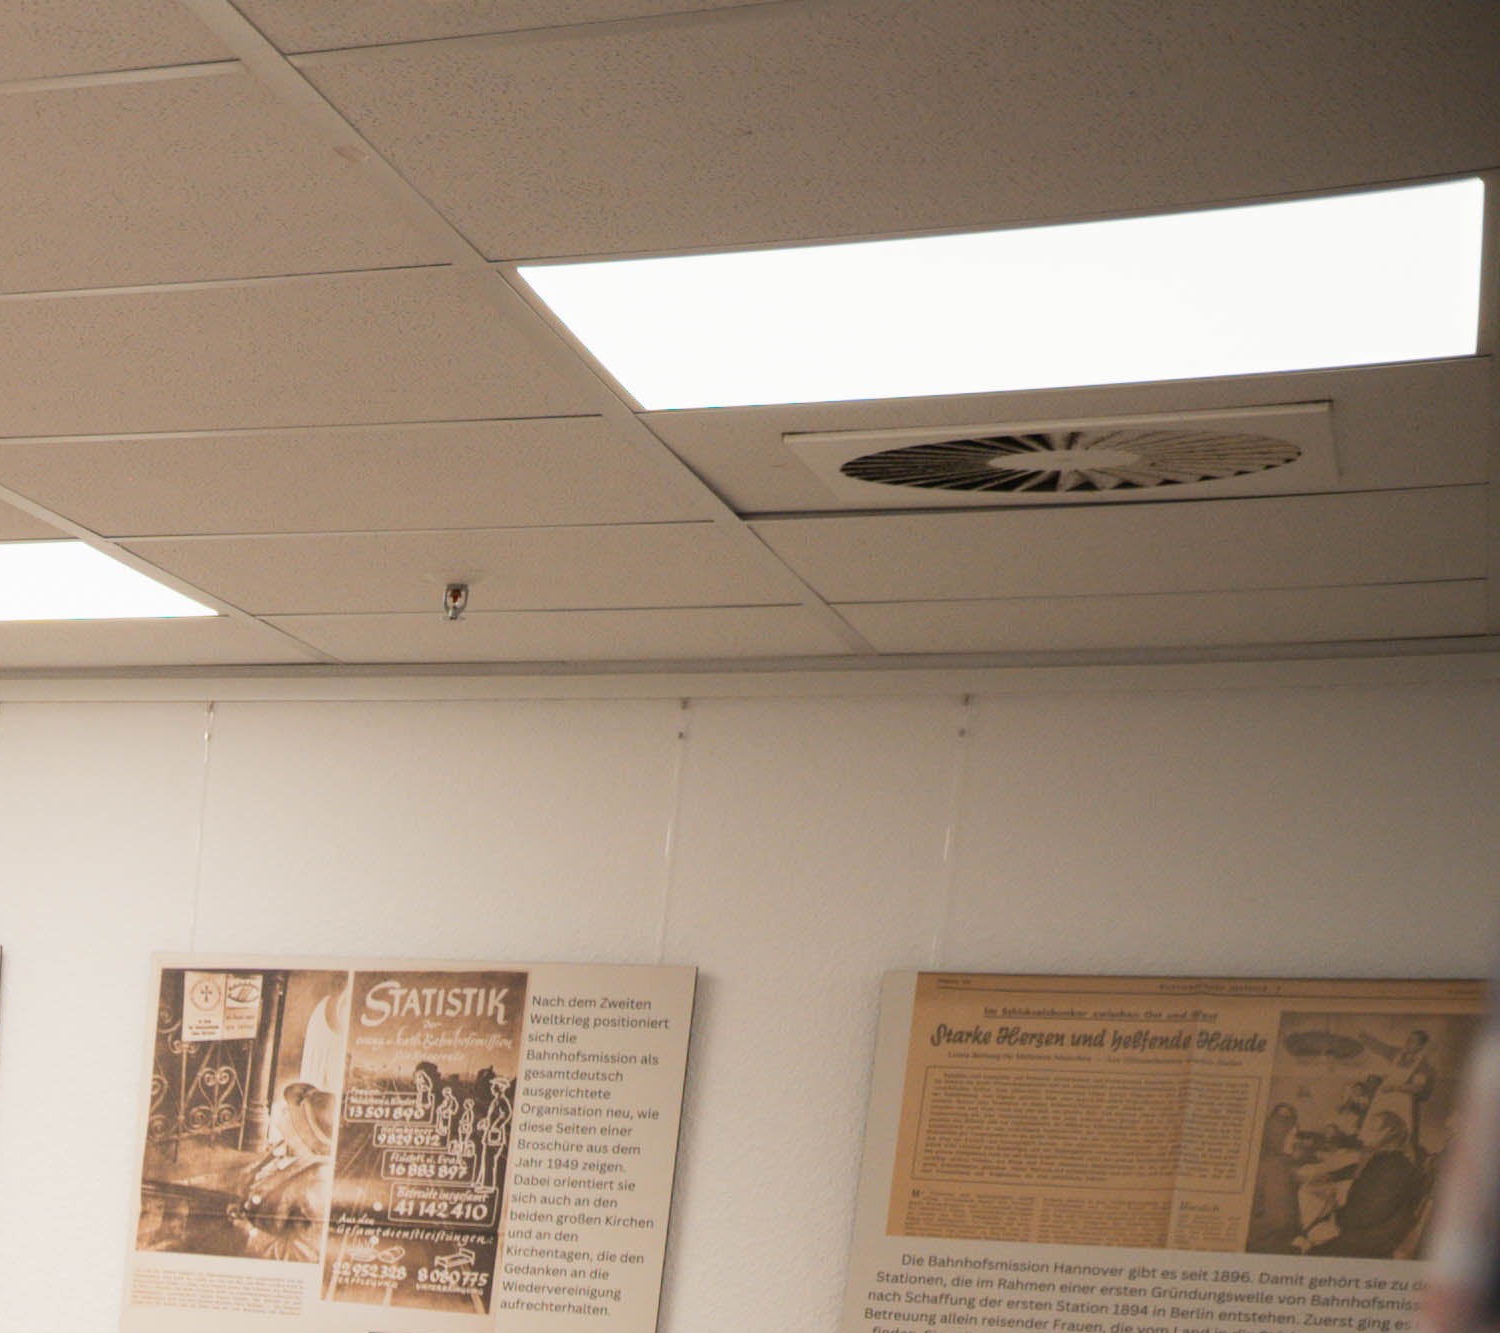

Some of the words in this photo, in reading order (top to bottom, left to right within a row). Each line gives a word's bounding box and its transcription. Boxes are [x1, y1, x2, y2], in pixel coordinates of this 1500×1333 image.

[361, 981, 510, 1027] STATISTIK
[532, 995, 564, 1007] Nach
[567, 996, 596, 1008] dem
[599, 997, 651, 1010] Zweiten
[530, 1013, 589, 1029] Weltkrieg
[592, 1016, 668, 1029] positioniert
[930, 1023, 992, 1046] Starke
[1070, 1028, 1106, 1048] und
[901, 1253, 924, 1266] Die
[927, 1255, 1049, 1272] Bahnhofsmission
[1053, 1262, 1124, 1276] Hannover
[1127, 1265, 1157, 1280] gibt
[1160, 1269, 1177, 1280] es
[1180, 1269, 1208, 1281] seit
[1211, 1269, 1253, 1283] 1896.
